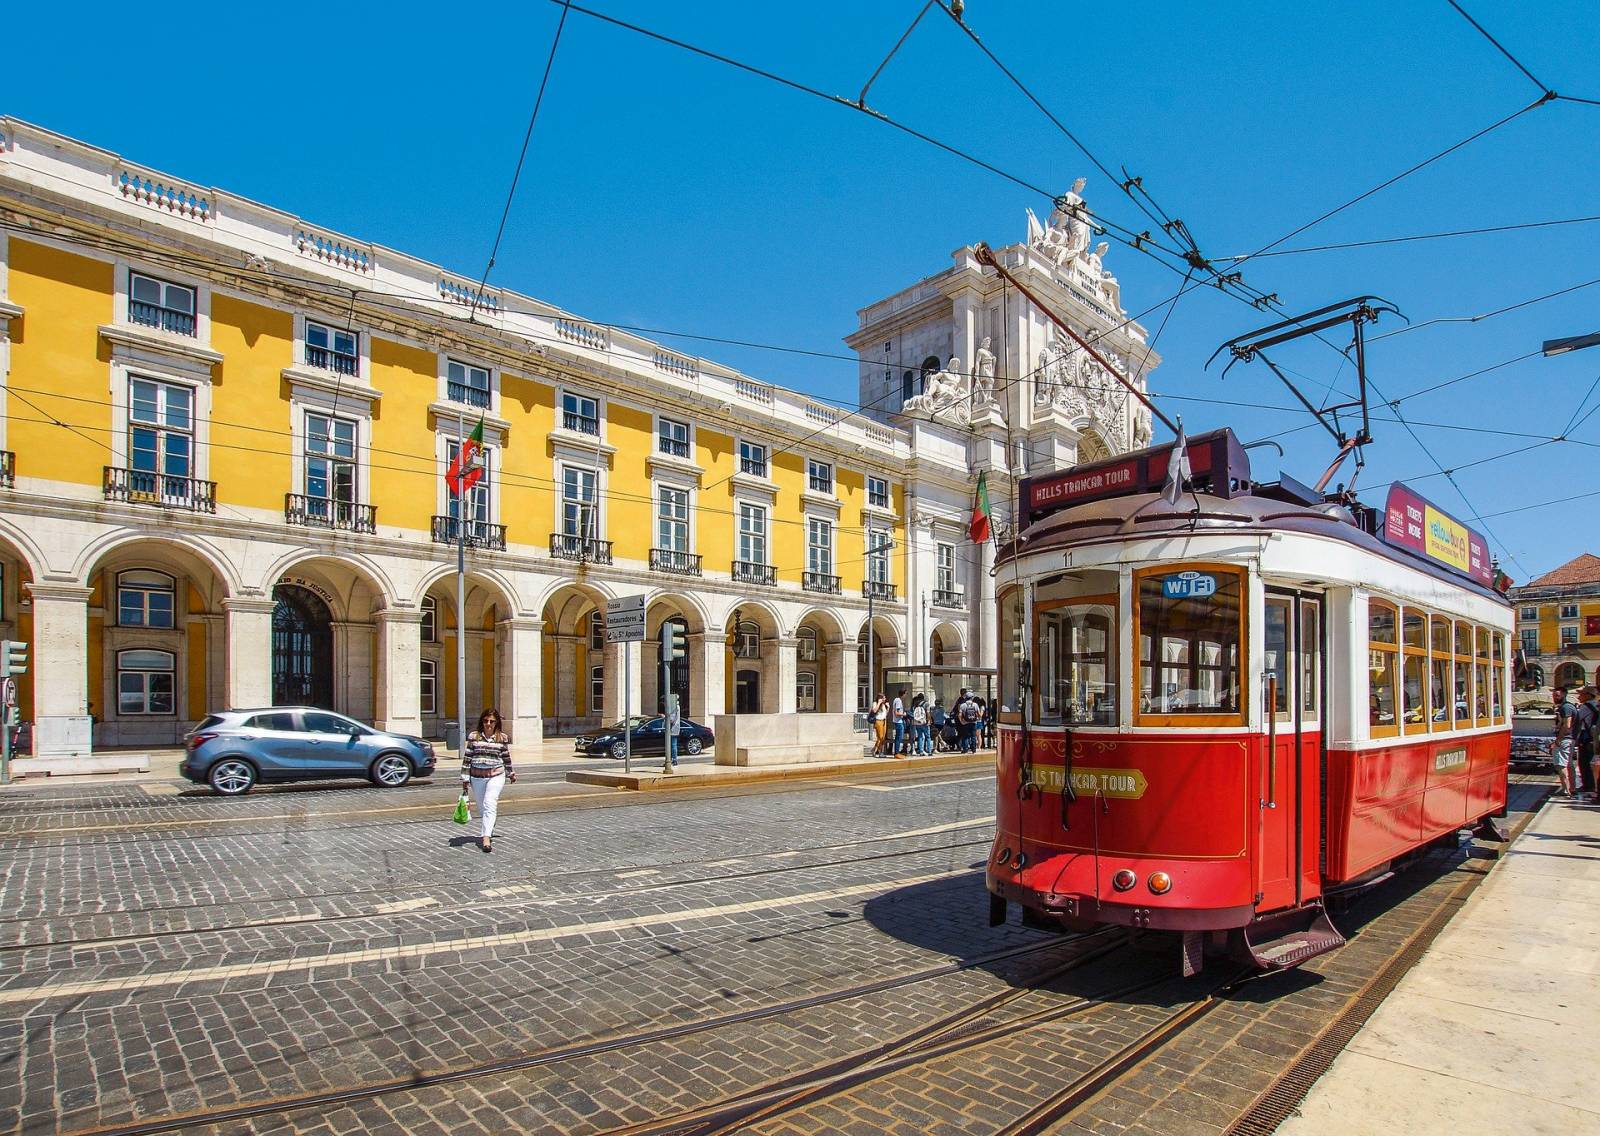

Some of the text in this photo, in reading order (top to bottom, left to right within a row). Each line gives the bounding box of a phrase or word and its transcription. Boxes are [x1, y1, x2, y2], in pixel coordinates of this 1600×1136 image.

[1036, 485, 1062, 501] HILLS
[1105, 468, 1130, 486] TOUR
[1062, 551, 1073, 567] 11
[1100, 774, 1136, 792] TOUR
